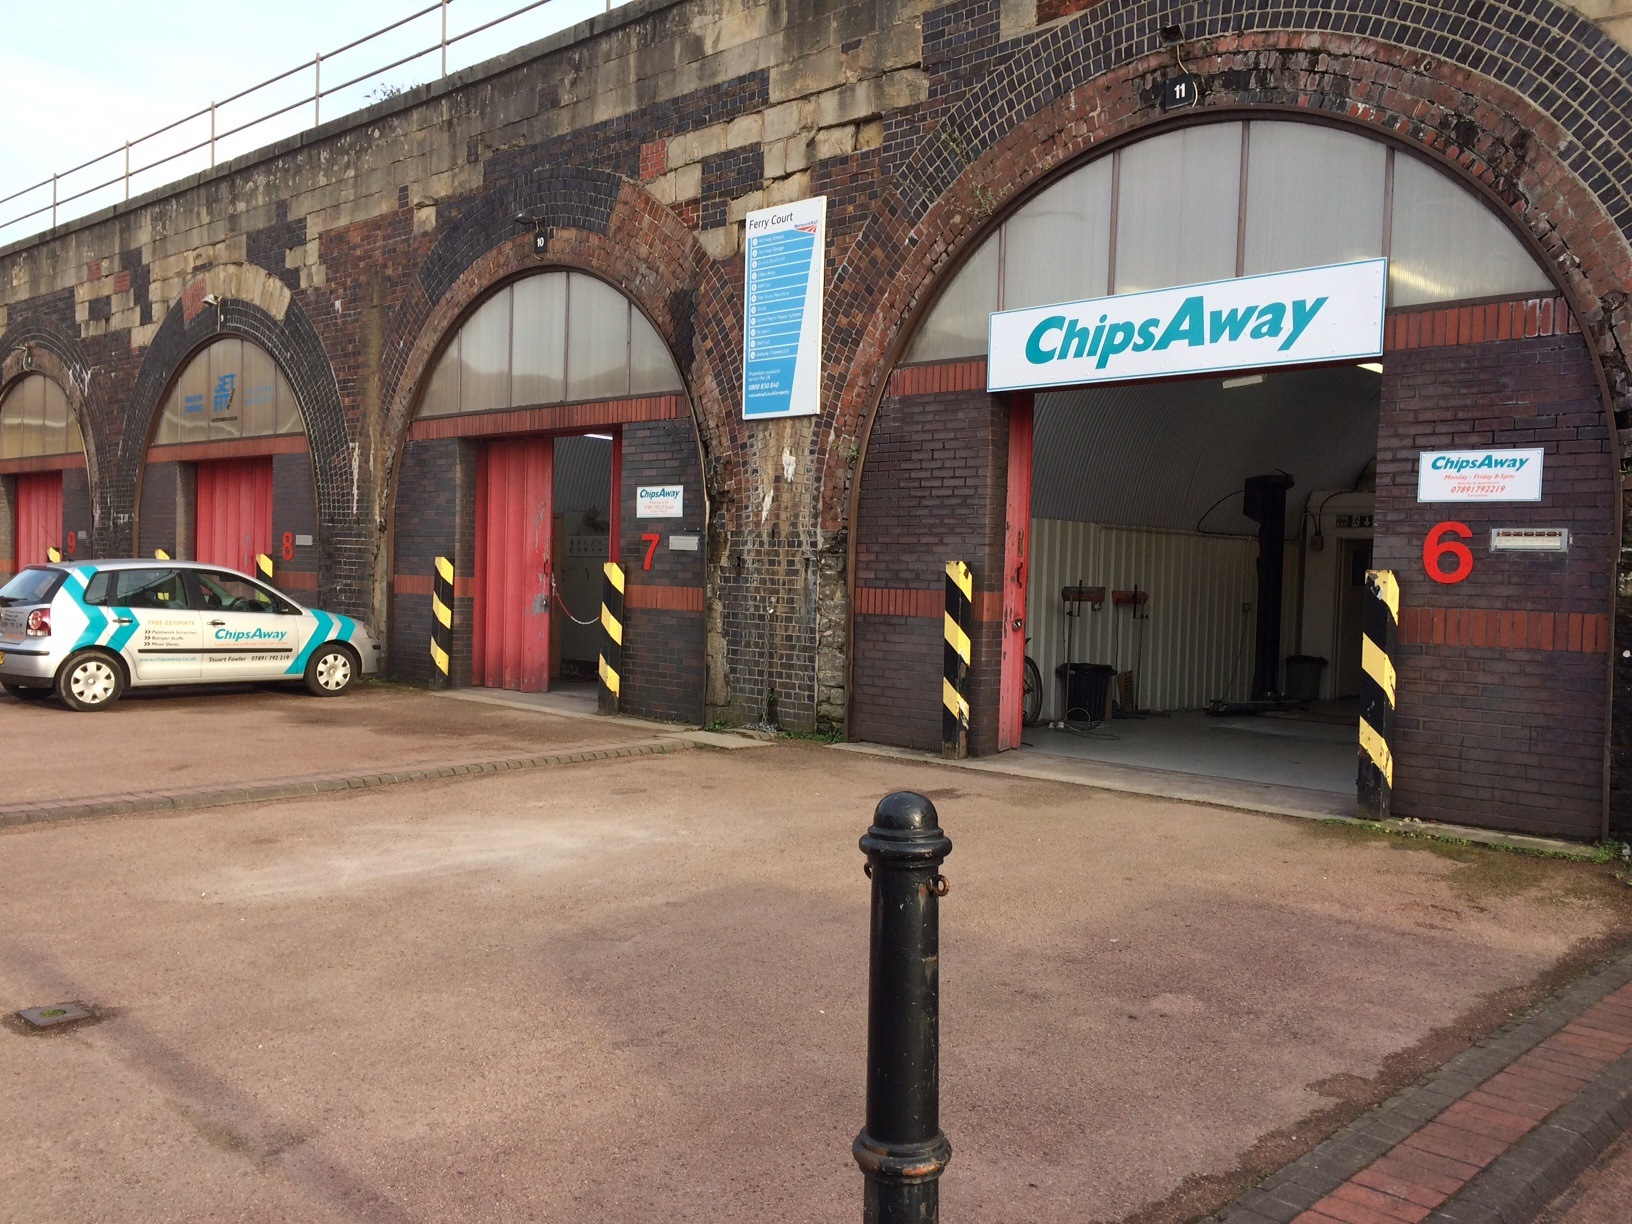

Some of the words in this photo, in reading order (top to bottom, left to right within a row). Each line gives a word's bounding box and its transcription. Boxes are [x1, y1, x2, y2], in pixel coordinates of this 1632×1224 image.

[1174, 82, 1186, 99] 11
[749, 219, 769, 230] Ferry
[771, 212, 793, 226] Court
[536, 236, 545, 248] 10
[1025, 295, 1329, 370] ChipsAway
[1431, 454, 1530, 472] ChipsAway
[640, 488, 680, 500] ChipsAway
[1450, 485, 1506, 493] 07891792219
[68, 530, 76, 555] 9
[282, 531, 294, 560] 8
[642, 534, 660, 572] 7
[1422, 520, 1474, 584] 6
[214, 628, 287, 642] ChipsAway
